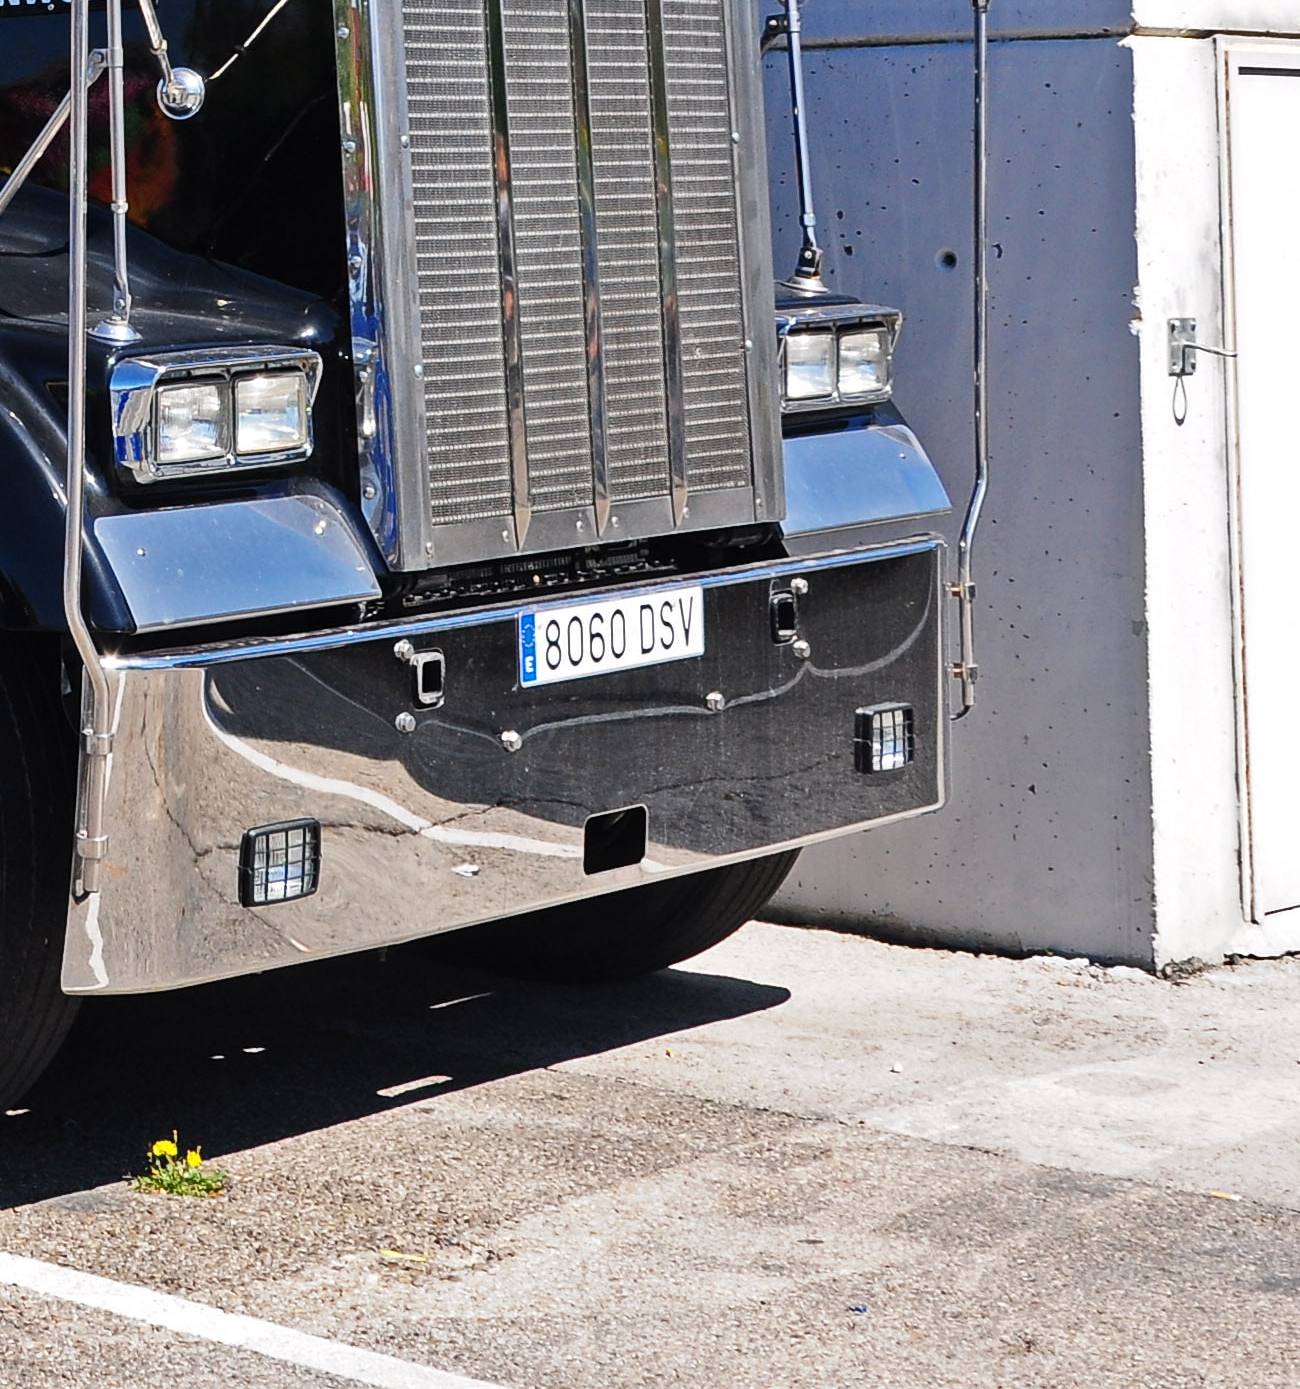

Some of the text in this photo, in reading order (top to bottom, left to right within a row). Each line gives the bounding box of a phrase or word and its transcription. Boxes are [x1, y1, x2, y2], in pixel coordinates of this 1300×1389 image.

[525, 596, 694, 673] E 8060 DSV
